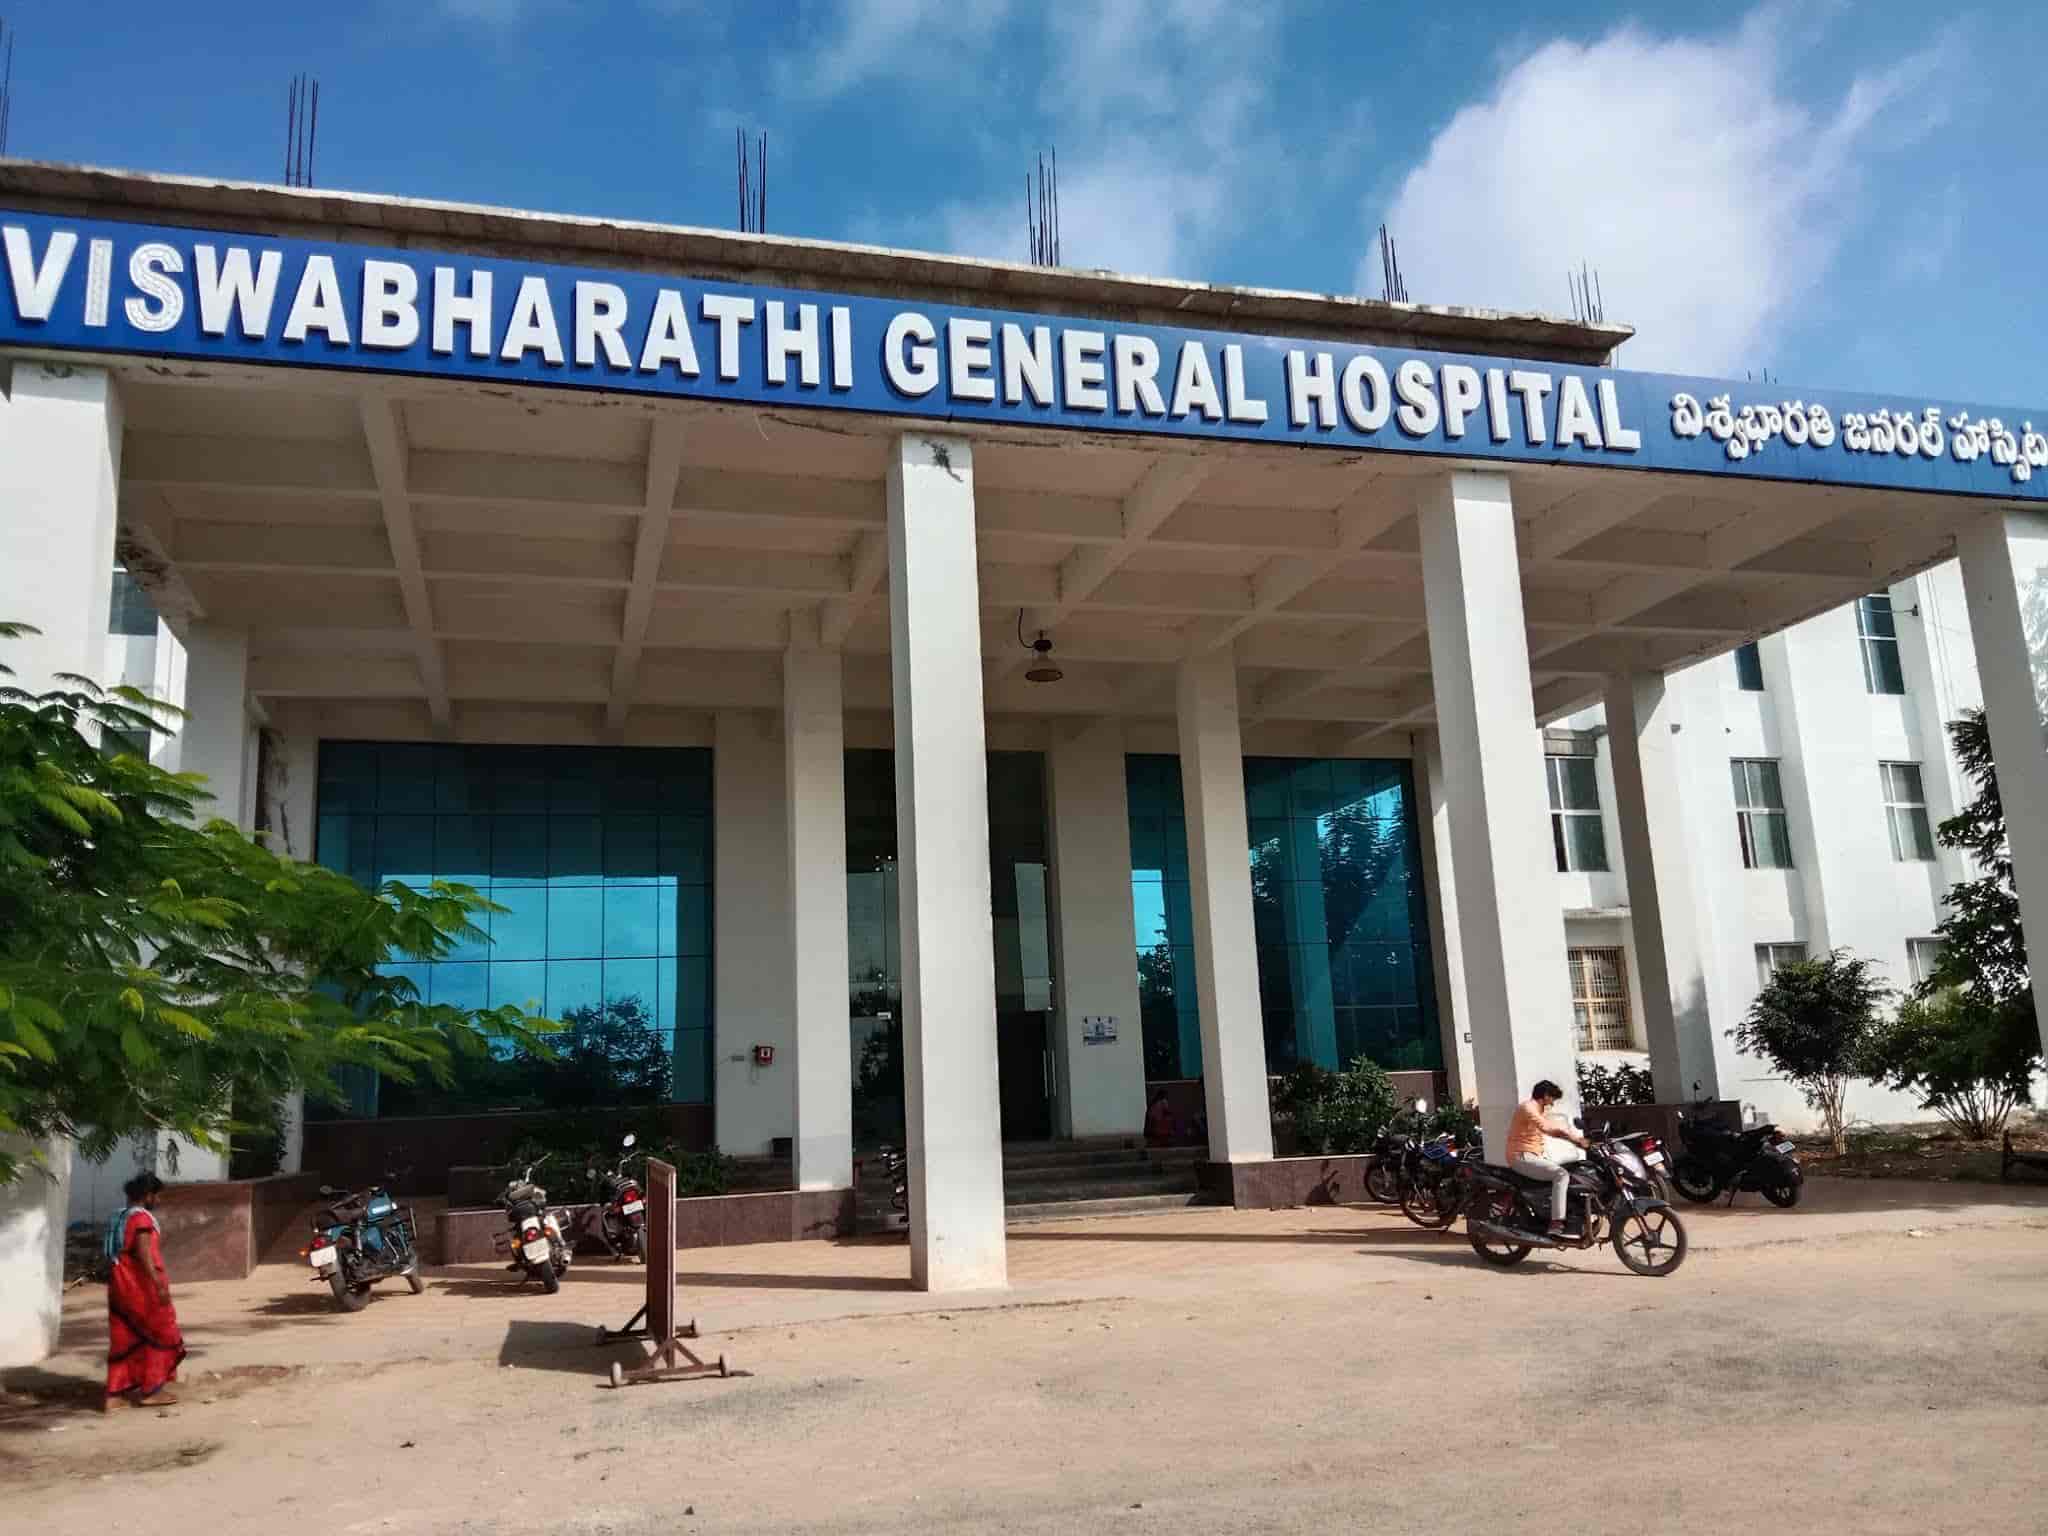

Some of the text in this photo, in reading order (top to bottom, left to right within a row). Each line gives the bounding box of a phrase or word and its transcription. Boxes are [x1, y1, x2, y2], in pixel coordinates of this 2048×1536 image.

[2, 226, 1642, 450] VISWABHARATHI GENERAL HOSPITAL
[1671, 391, 1836, 459] విశ్వభారతి
[1844, 408, 1944, 457] జనరల్
